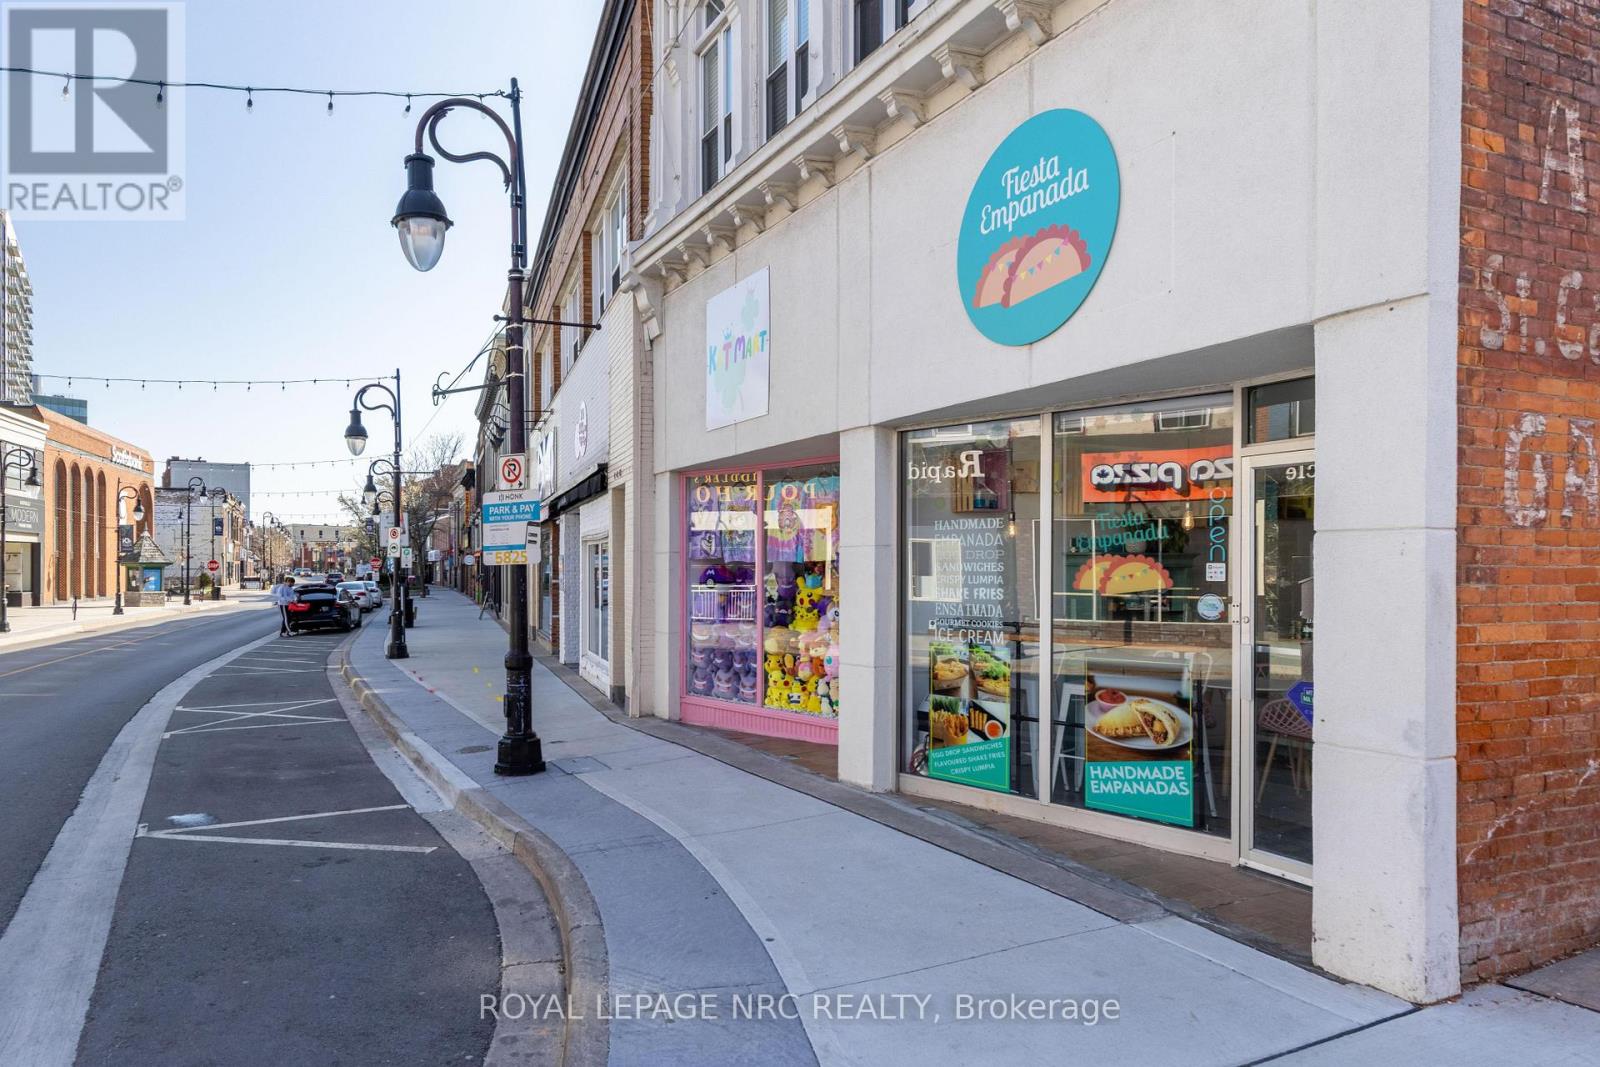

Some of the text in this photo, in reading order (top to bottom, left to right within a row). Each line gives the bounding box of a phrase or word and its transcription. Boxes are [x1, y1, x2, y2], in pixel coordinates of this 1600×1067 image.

[1001, 155, 1060, 200] Fiesta
[980, 167, 1089, 235] Empanada
[489, 504, 536, 515] PARK & PAY
[934, 517, 1005, 530] HANDMADE
[1097, 510, 1146, 530] Fiesta
[965, 549, 1005, 560] DROP
[968, 574, 1004, 585] LUMPIA
[974, 587, 1004, 600] FRIES
[971, 620, 1004, 628] COOKIES
[934, 627, 1005, 645] ICE CREAM
[945, 749, 961, 757] DROP
[962, 741, 1004, 754] SANDWICHES
[934, 757, 967, 768] FLAVOURED
[989, 751, 1006, 759] FRIES
[950, 767, 972, 775] CRISPY
[1090, 766, 1186, 780] HANDMADE
[1090, 780, 1190, 796] EMPANADAS
